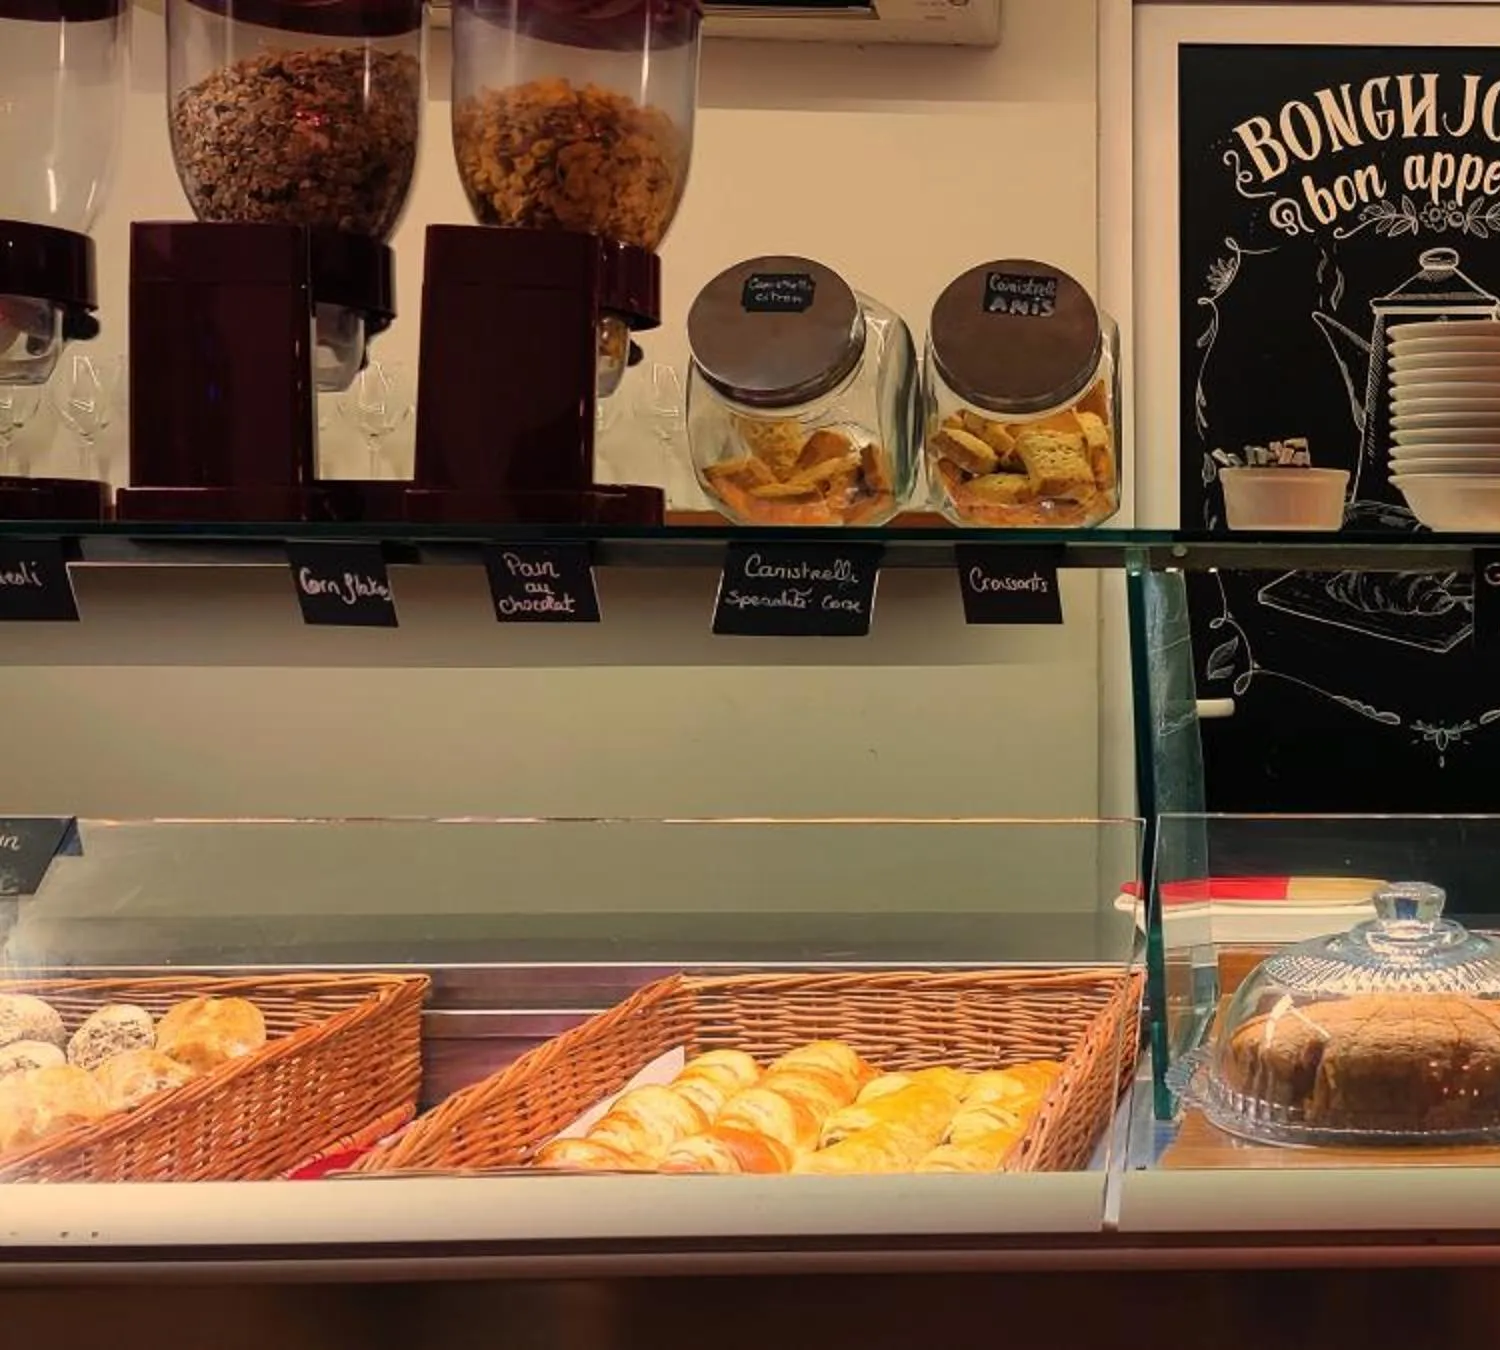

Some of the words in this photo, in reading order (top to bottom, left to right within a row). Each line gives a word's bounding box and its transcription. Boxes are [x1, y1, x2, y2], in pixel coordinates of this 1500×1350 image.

[1301, 162, 1387, 225] bon
[503, 551, 560, 578] Pain
[525, 582, 556, 595] au
